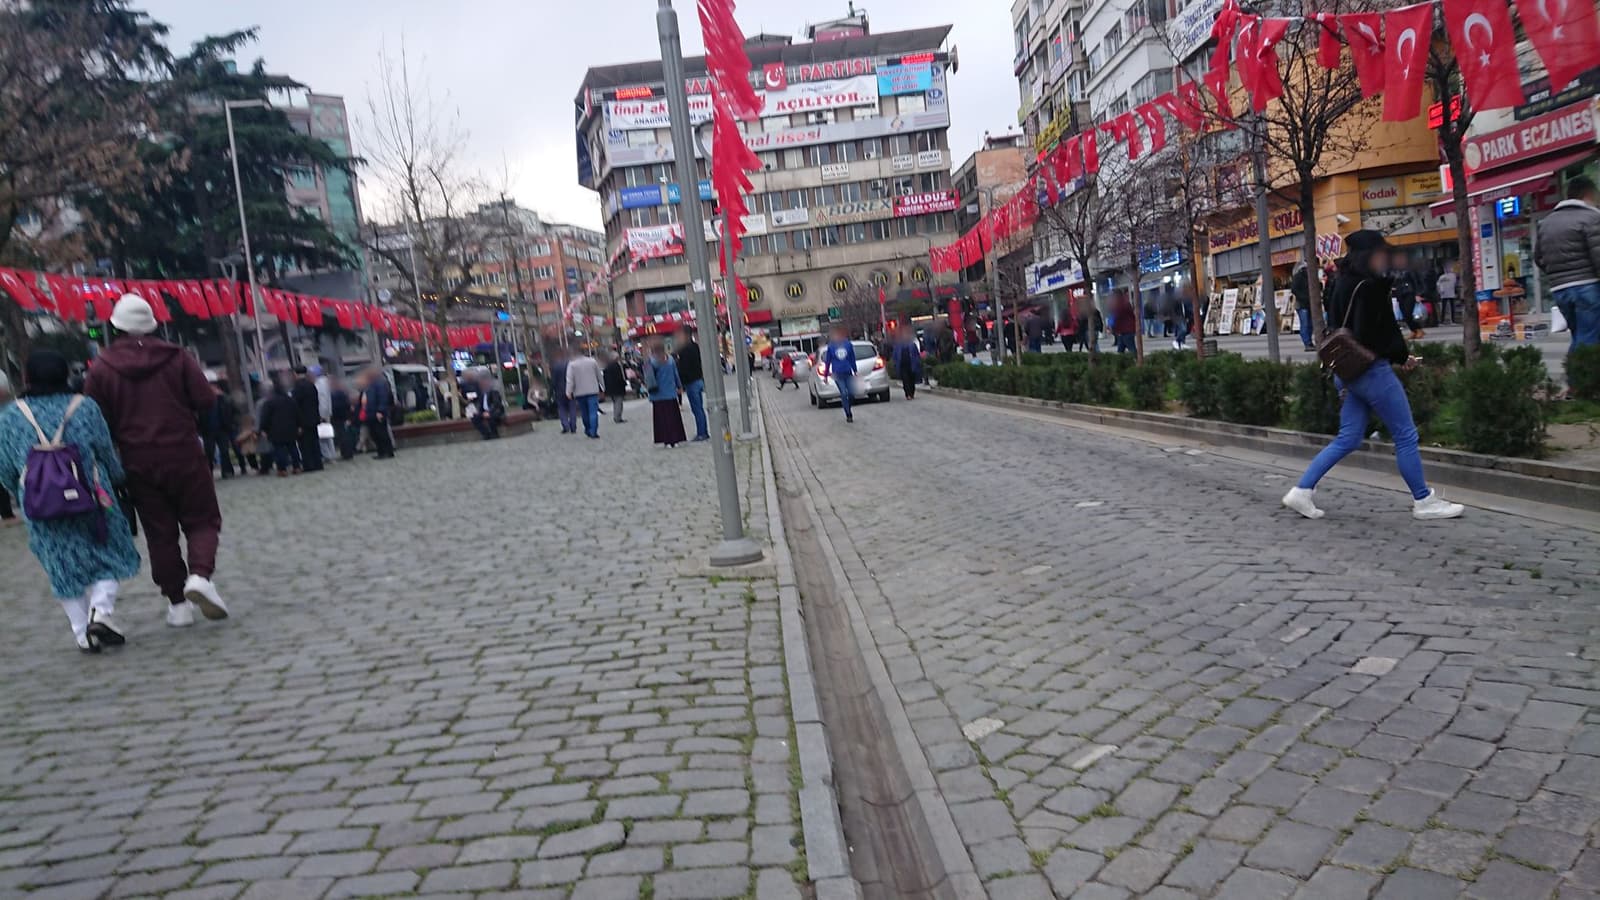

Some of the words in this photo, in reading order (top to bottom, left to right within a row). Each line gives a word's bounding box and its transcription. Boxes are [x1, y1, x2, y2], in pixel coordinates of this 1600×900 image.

[614, 102, 644, 116] final
[650, 97, 708, 115] akemi
[1482, 133, 1518, 162] PARK
[904, 192, 947, 205] SULDUZ
[1362, 187, 1398, 200] Kodak
